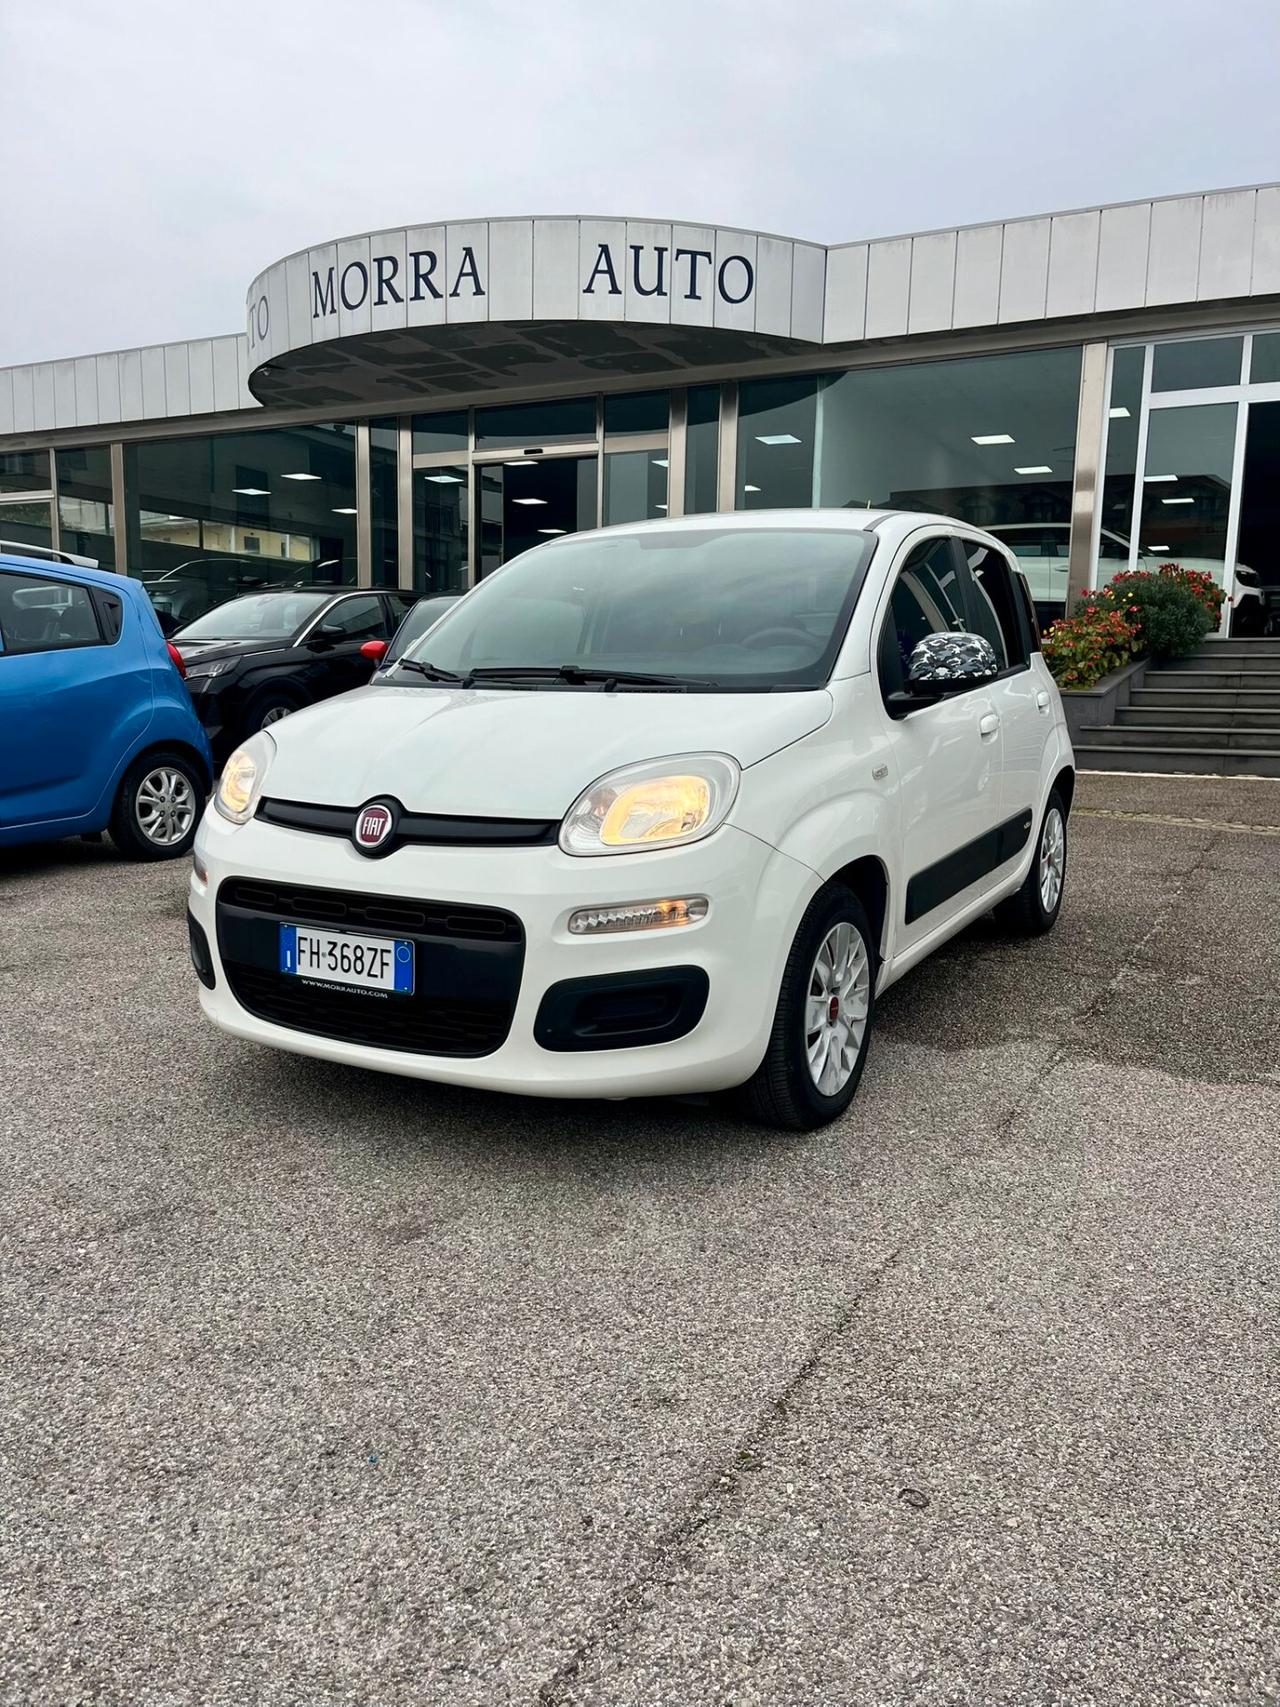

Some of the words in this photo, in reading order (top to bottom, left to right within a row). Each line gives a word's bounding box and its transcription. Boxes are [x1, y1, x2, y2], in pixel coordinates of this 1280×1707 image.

[312, 246, 486, 319] MORRA
[582, 243, 754, 304] AUTO
[361, 816, 385, 836] FIAT
